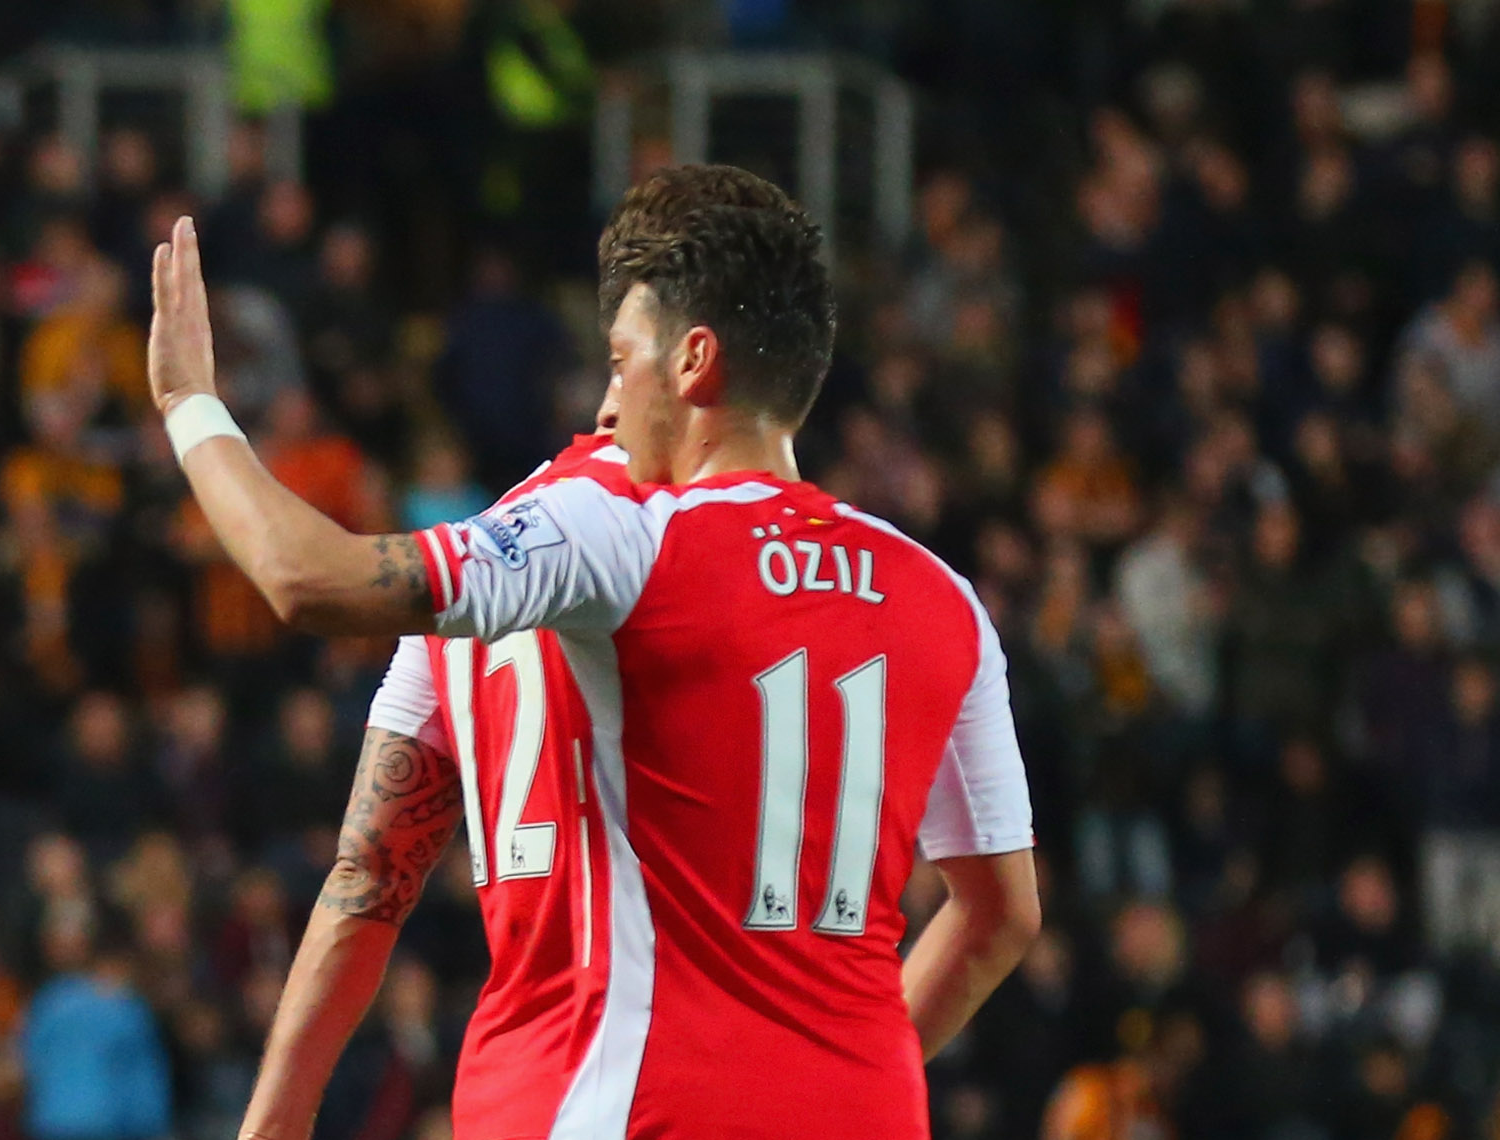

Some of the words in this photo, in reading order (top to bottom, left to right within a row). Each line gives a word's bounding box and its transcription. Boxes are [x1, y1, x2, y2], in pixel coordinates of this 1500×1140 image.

[752, 523, 886, 603] ÖZIL
[444, 628, 556, 887] 12
[743, 646, 886, 937] 11
